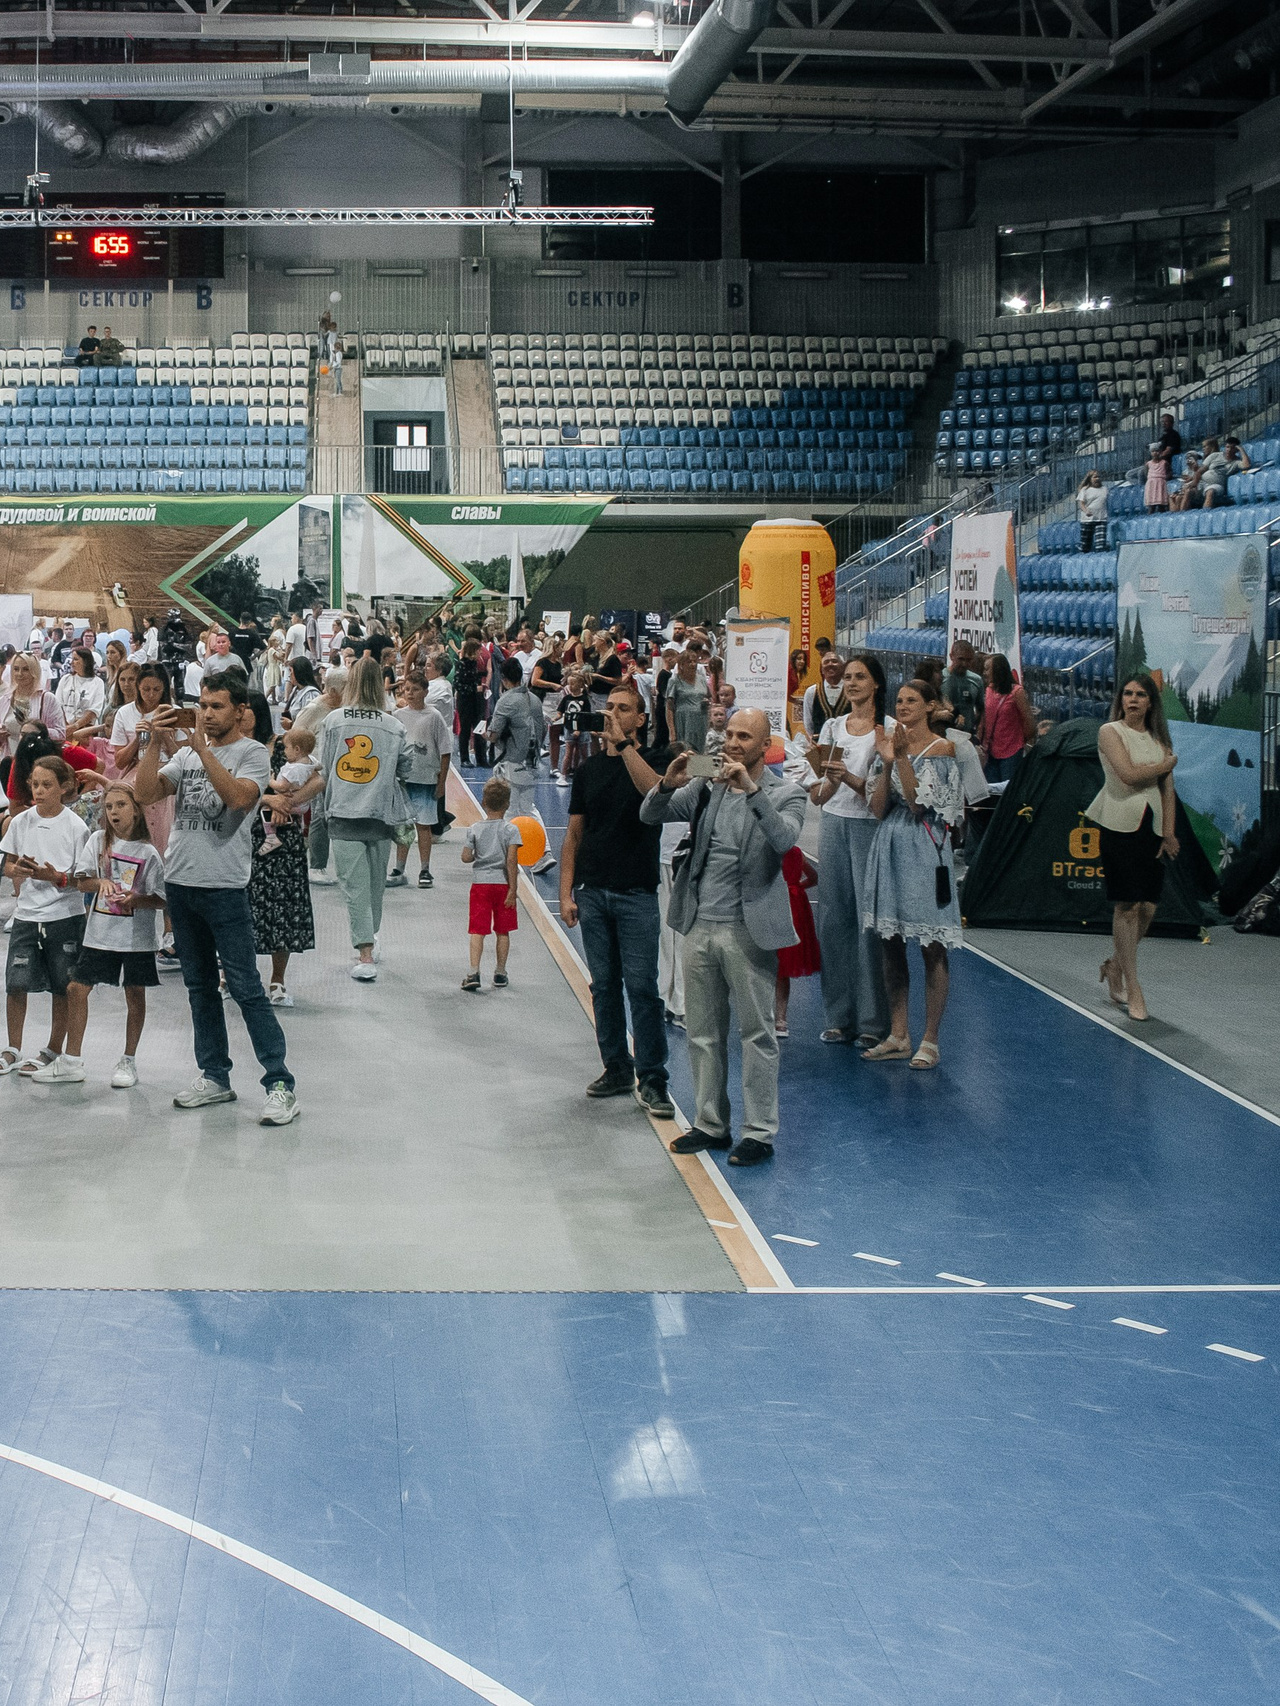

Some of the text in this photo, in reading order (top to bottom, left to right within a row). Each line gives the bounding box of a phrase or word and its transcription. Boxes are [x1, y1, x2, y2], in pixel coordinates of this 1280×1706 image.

[79, 291, 153, 308] СЕКТОР
[568, 291, 640, 307] СЕКТОР
[67, 508, 79, 521] и
[82, 503, 156, 521] воинской
[451, 506, 502, 520] славы
[954, 564, 978, 591] УСПЕЙ
[953, 598, 1004, 623] ЗАПИСАТЬСЯ
[344, 708, 382, 722] BIEBER
[188, 821, 198, 831] TO
[202, 821, 224, 832] LIVE
[1052, 861, 1105, 878] BTrac
[1067, 881, 1094, 889] Cloud
